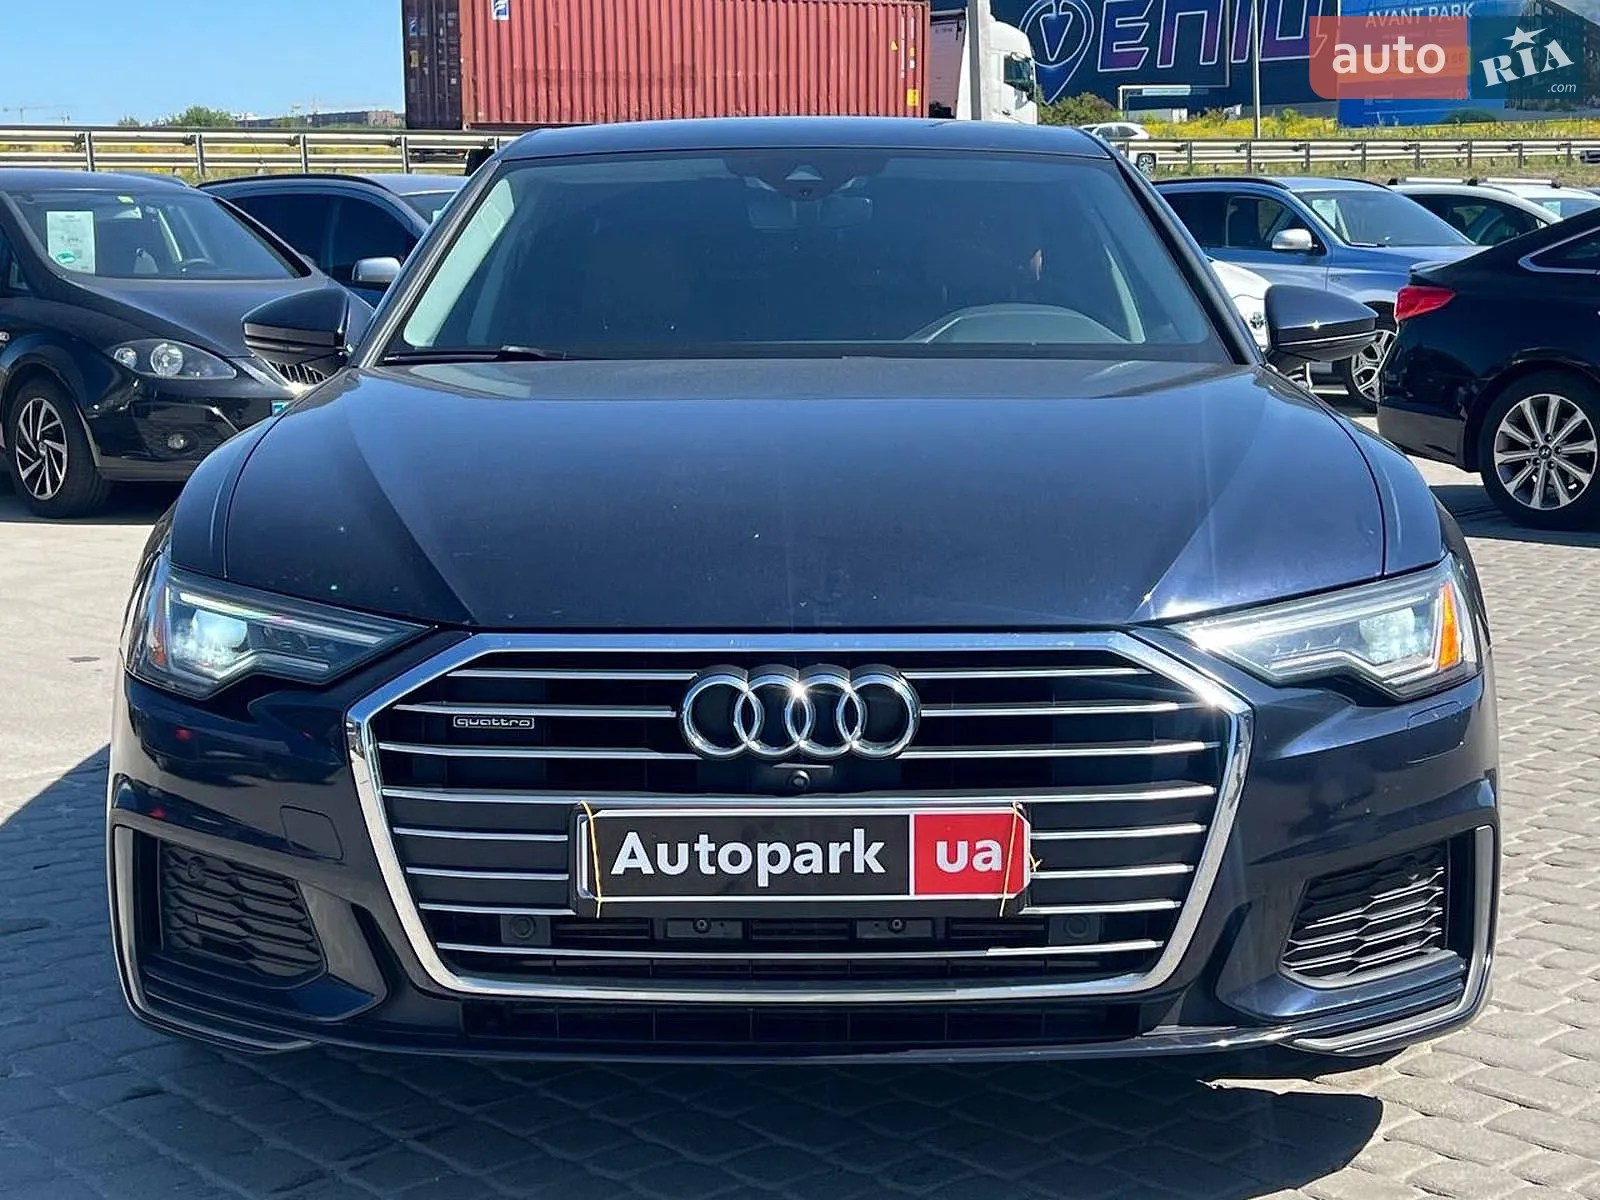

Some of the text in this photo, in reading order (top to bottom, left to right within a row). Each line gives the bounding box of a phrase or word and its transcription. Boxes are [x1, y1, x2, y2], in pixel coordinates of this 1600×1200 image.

[1364, 3, 1474, 29] AVANT PARK
[456, 717, 531, 727] quattro
[610, 828, 1003, 887] Autopark ua
